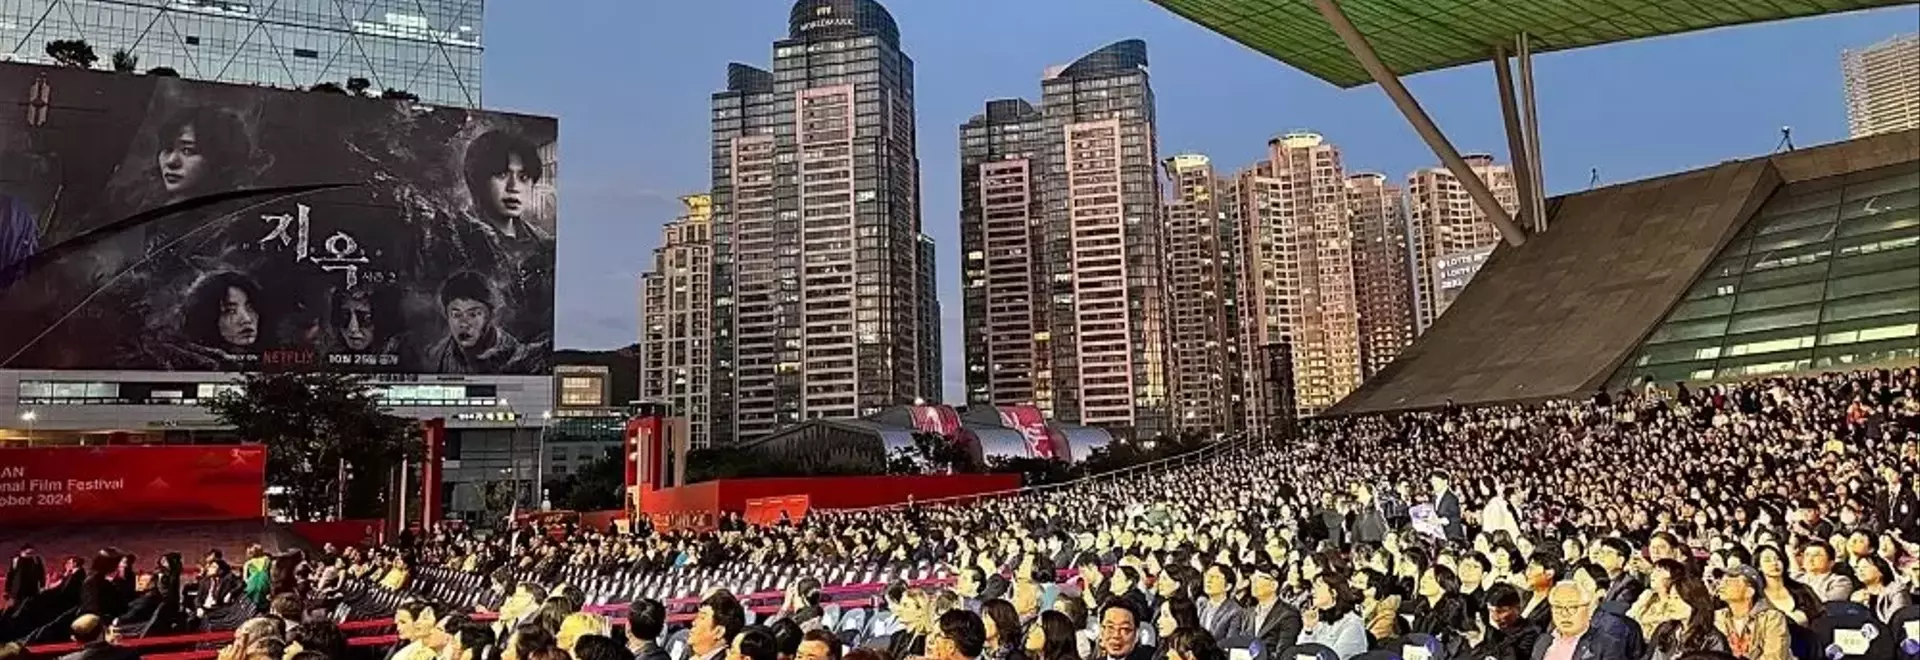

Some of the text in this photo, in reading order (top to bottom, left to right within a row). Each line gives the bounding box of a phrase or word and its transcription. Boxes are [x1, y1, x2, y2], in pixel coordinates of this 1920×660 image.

[258, 203, 369, 290] 지옥
[263, 350, 315, 365] NETFLIX
[29, 479, 63, 492] Film
[67, 478, 124, 491] Festival
[37, 493, 73, 505] 2024
